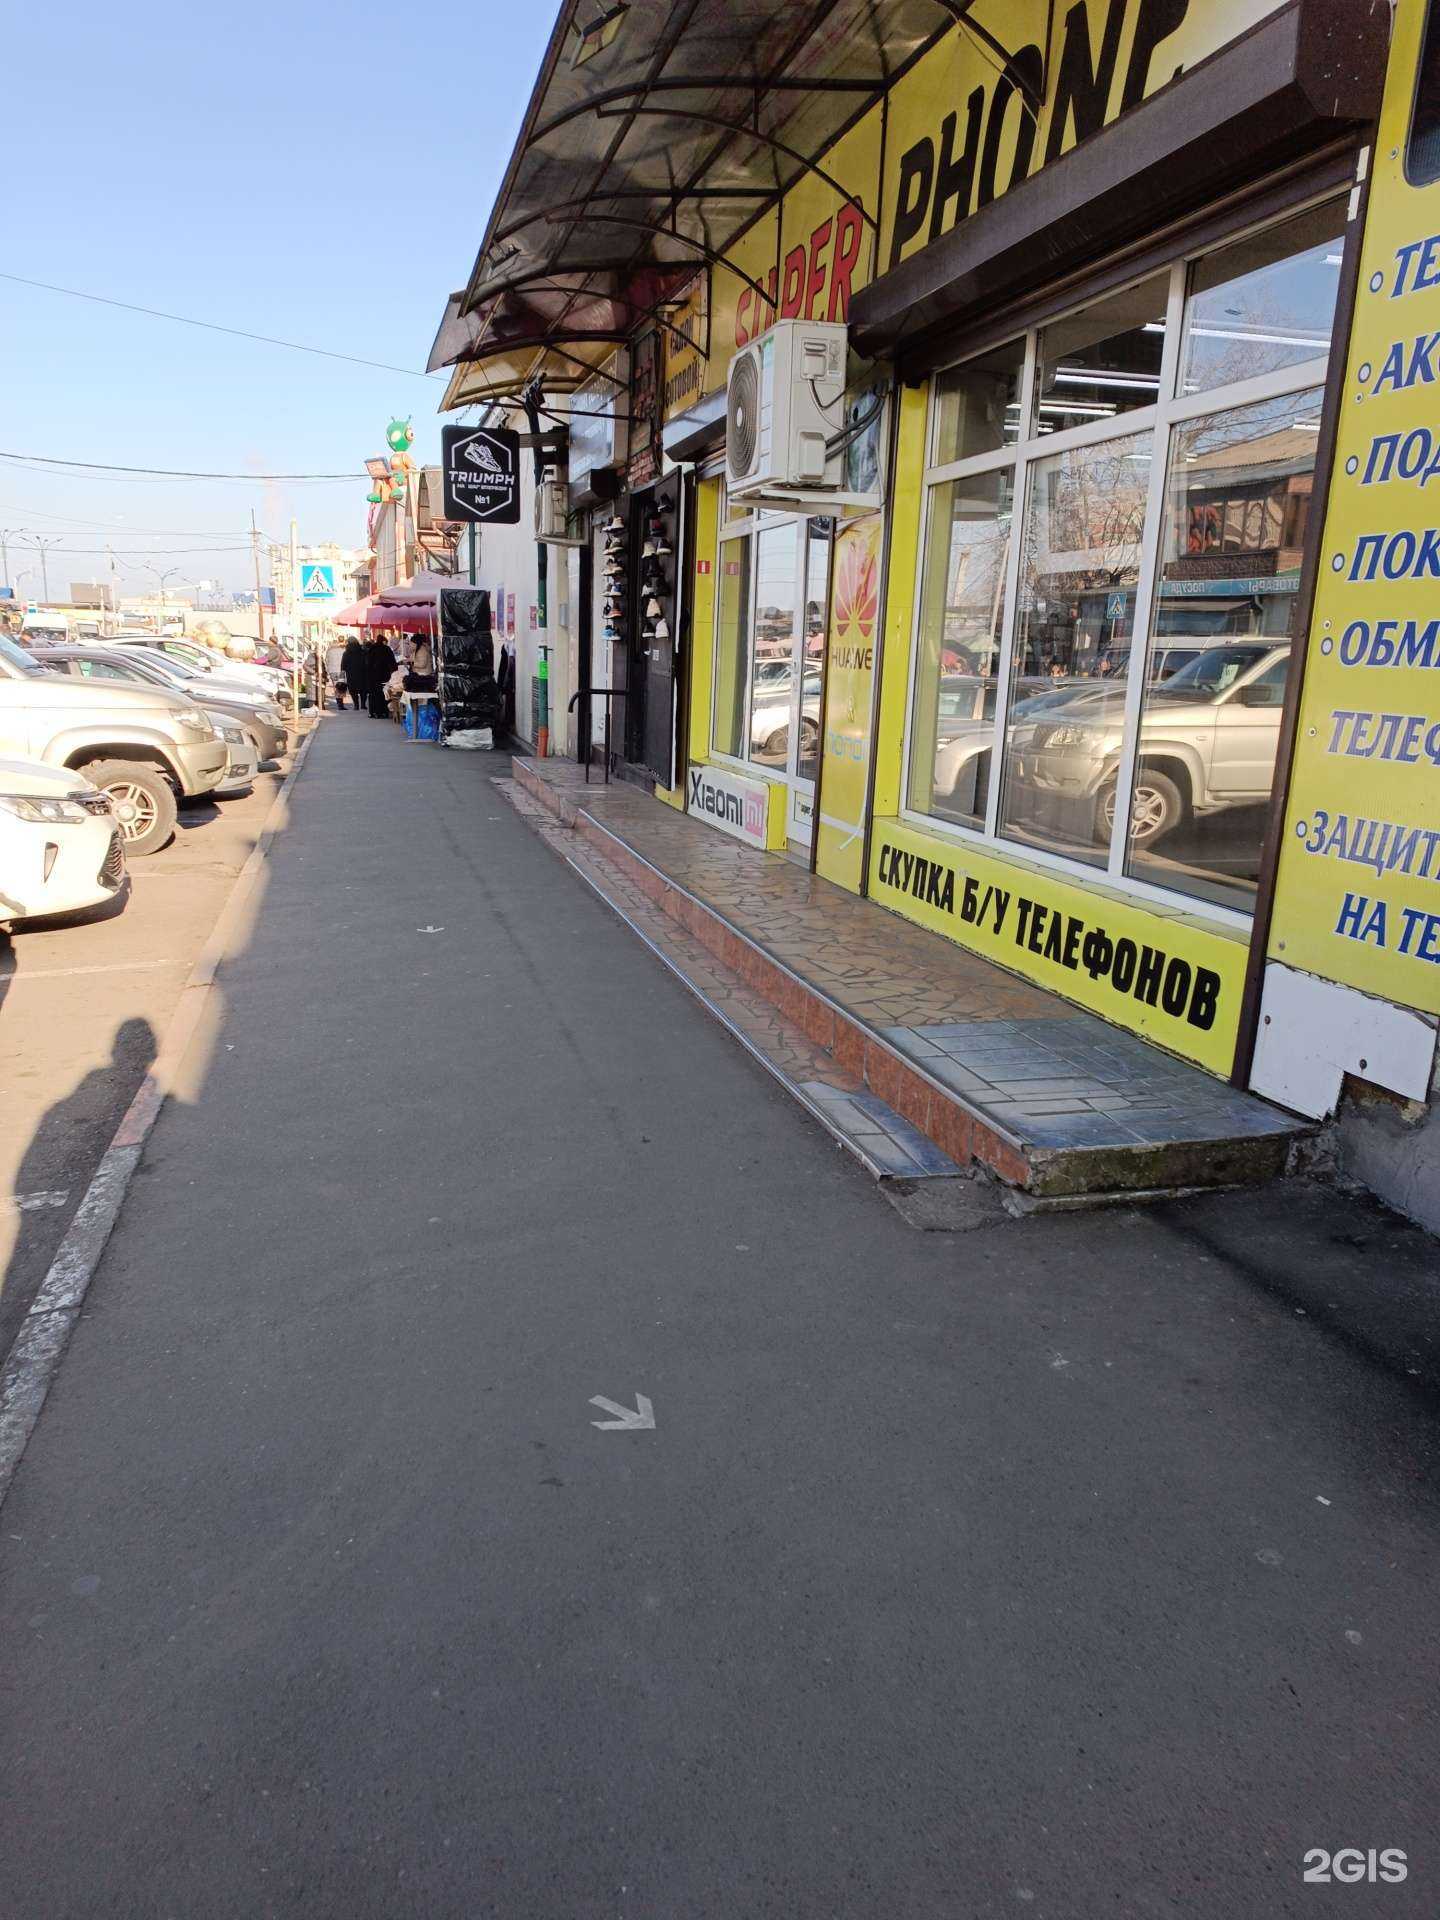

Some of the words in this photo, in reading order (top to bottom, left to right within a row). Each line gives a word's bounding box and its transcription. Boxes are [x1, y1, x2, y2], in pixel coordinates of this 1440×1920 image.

[1391, 234, 1440, 297] ТЕ
[1371, 331, 1440, 395] АК
[448, 470, 515, 486] TRIUMPH
[474, 494, 490, 505] №1
[1339, 620, 1440, 667] ОБМ
[1305, 811, 1440, 882] ЗАЩИТ
[879, 844, 954, 914] СКУПКА
[960, 876, 1011, 935] Б/У
[1016, 897, 1221, 1031] ТЕЛЕФОНОВ
[1334, 892, 1386, 947] НА
[1398, 907, 1440, 964] ТЕ
